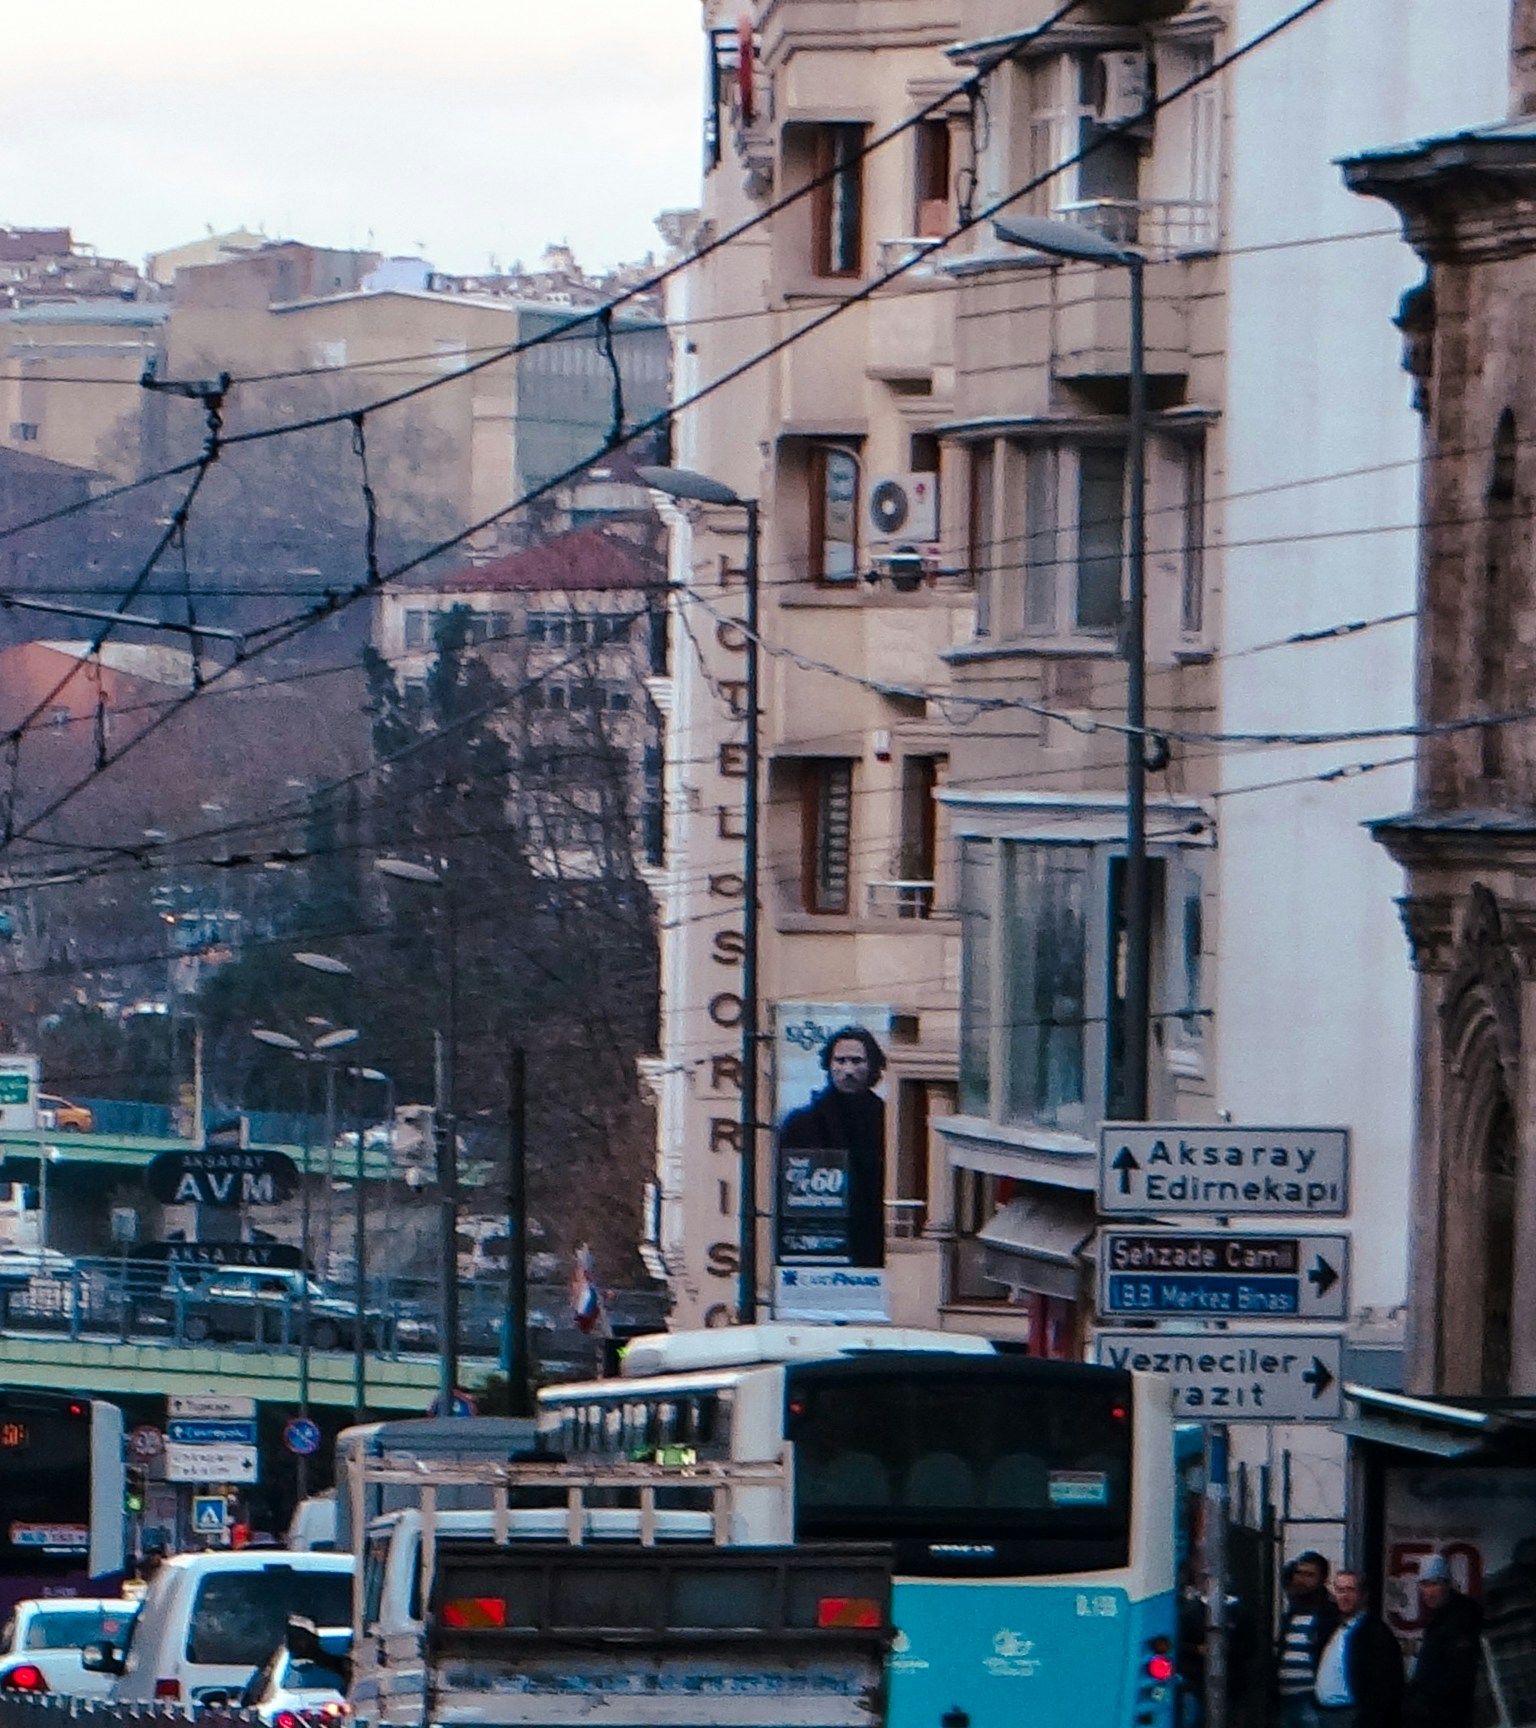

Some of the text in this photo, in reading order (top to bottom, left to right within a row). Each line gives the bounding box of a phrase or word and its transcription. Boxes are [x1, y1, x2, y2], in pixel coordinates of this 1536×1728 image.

[1147, 1140, 1317, 1174] Aksaray
[173, 1172, 276, 1202] AVM
[1146, 1174, 1337, 1208] Edirnekapı
[1113, 1240, 1217, 1269] Şehzade
[1107, 1347, 1299, 1375] Vezneciler
